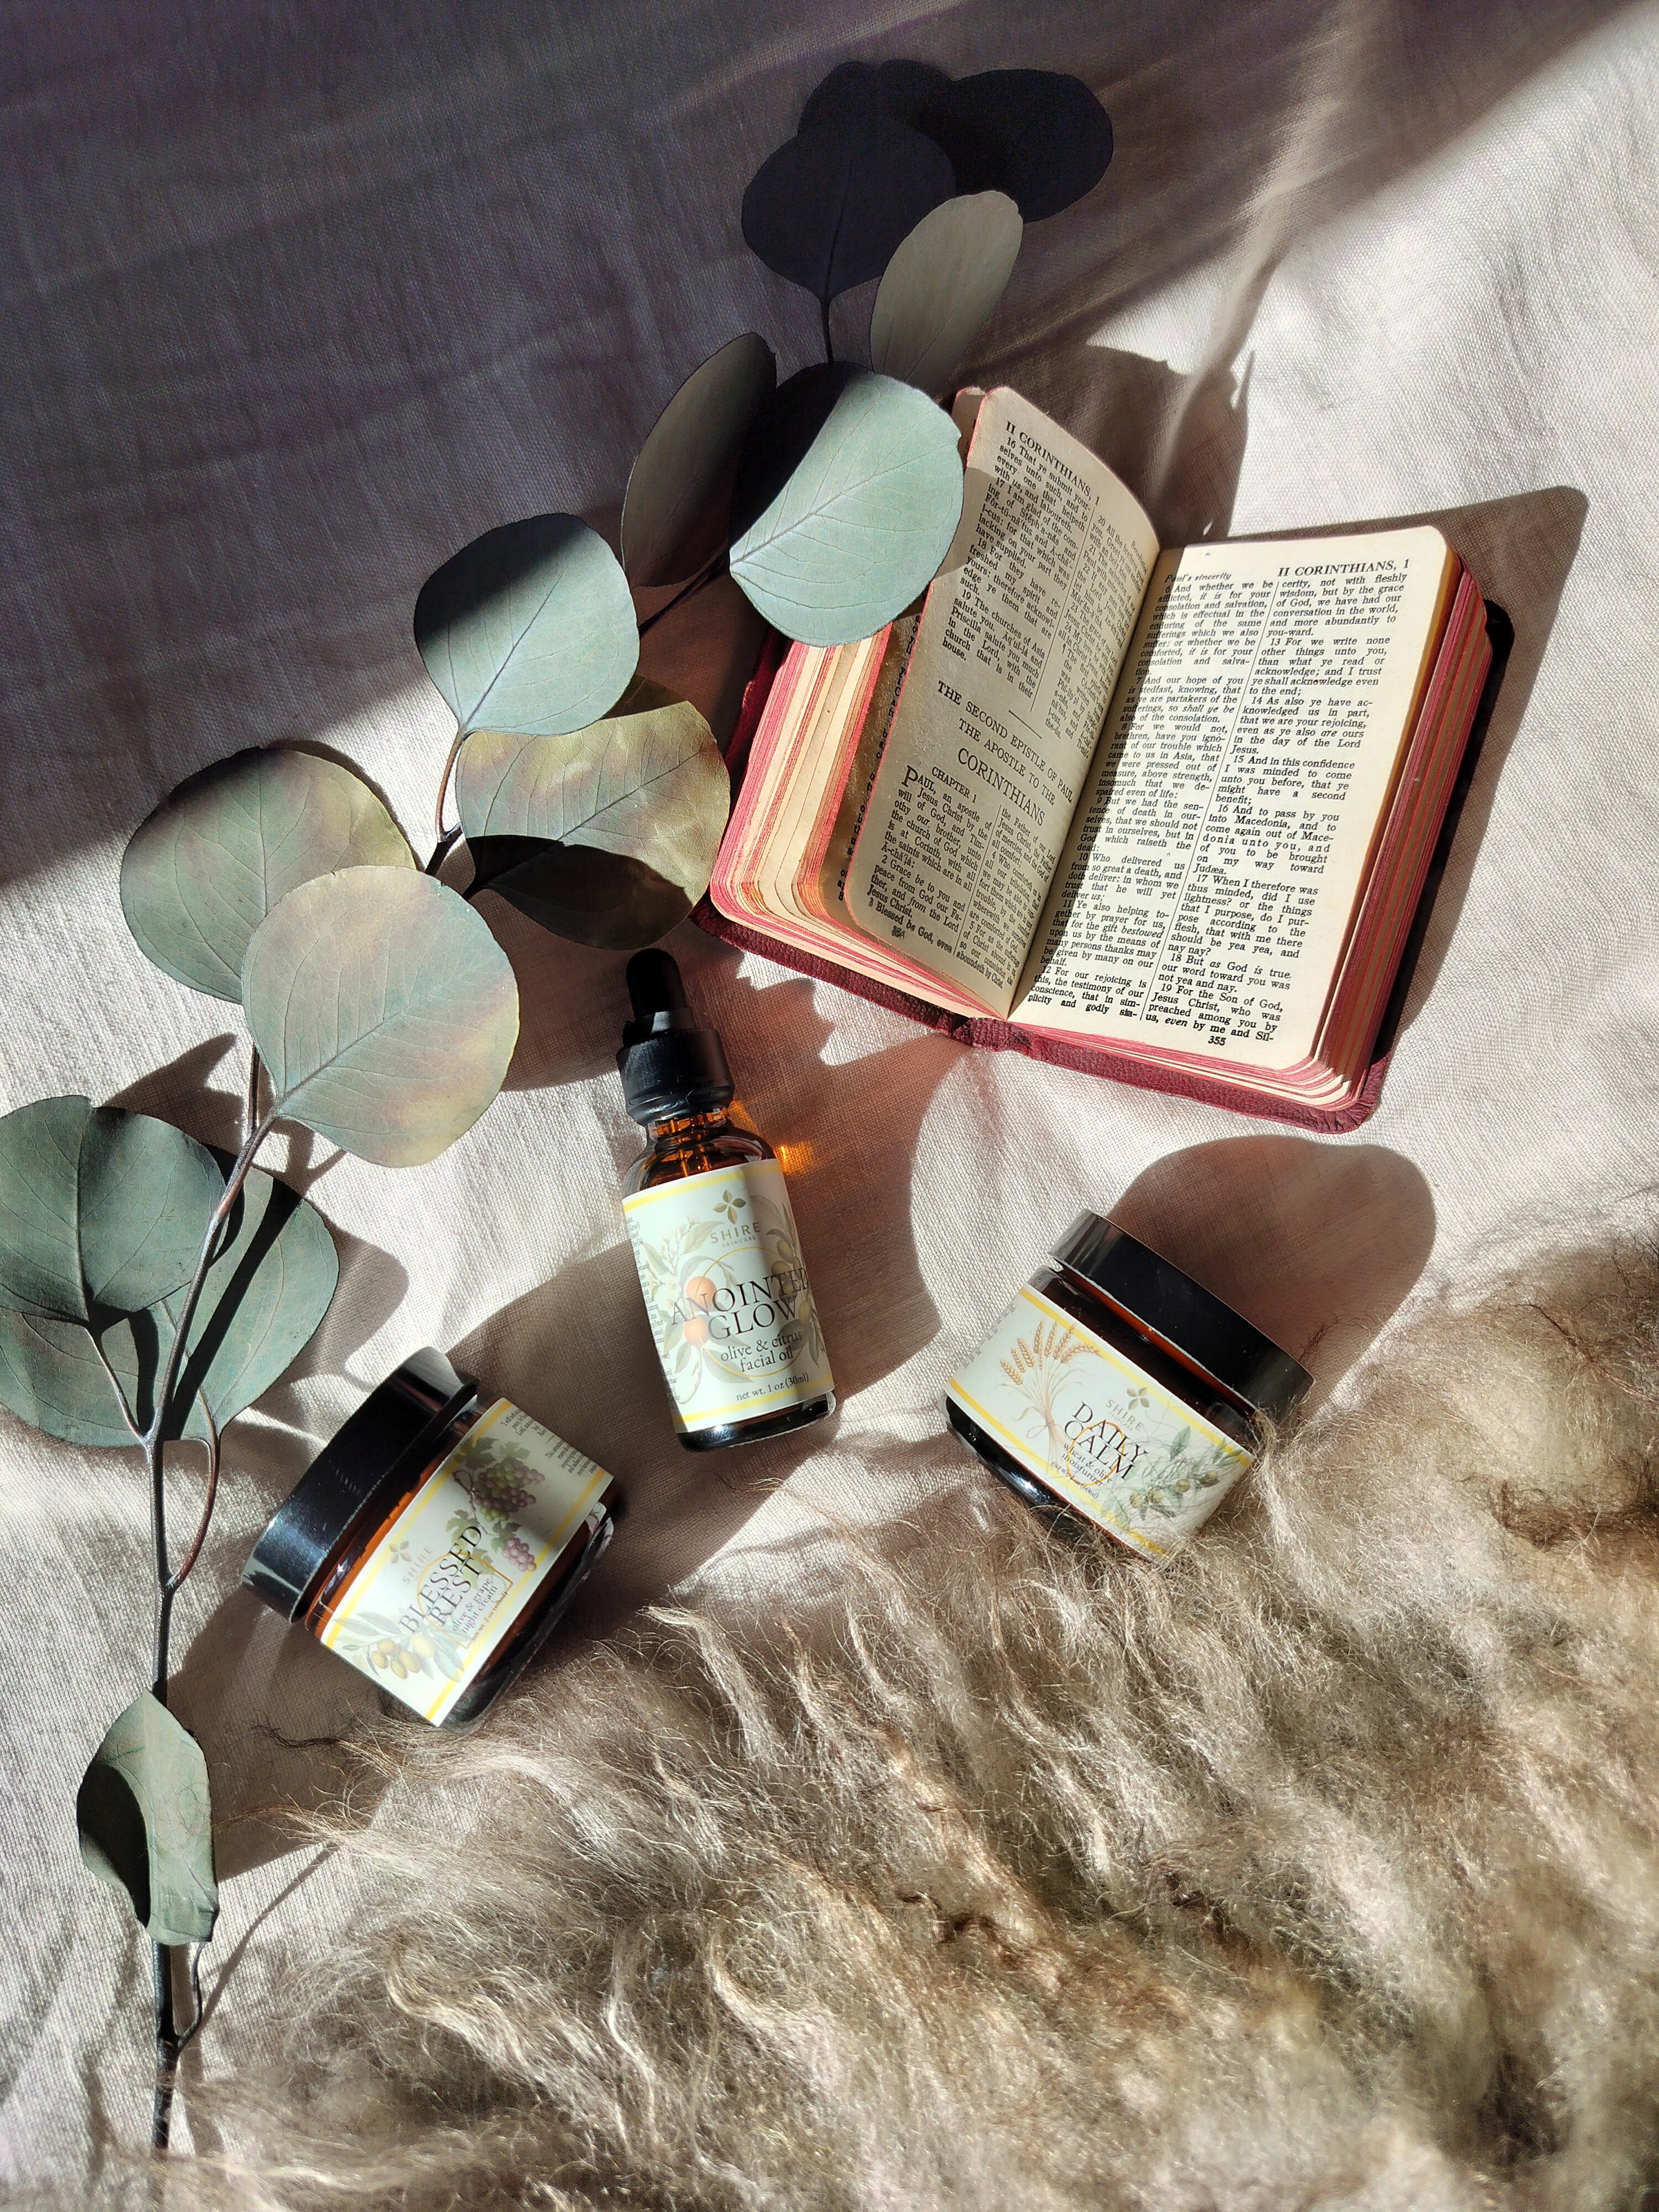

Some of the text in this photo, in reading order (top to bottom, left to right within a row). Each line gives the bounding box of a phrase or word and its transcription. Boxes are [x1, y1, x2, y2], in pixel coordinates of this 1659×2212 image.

[1005, 420, 1015, 435] II
[1019, 431, 1092, 500] CORINTHIANS,
[1000, 444, 1088, 522] selves unto such, and to
[1006, 437, 1091, 511] 16 That ye submit your-
[1165, 574, 1192, 583] Paul's
[1277, 559, 1409, 577] II CORINTHIANS, 1
[1282, 572, 1407, 589] cerity, not with fleshly
[1276, 599, 1286, 607] of
[1290, 599, 1311, 608] God,
[1363, 595, 1379, 603] had
[1322, 588, 1338, 596] but
[1342, 586, 1355, 597] by
[1359, 585, 1374, 594] the
[1378, 585, 1404, 594] grace
[1150, 621, 1185, 630] enduring
[1194, 619, 1204, 628] of
[1193, 610, 1230, 618] effectual
[1270, 618, 1288, 626] and
[1324, 615, 1380, 625] abundantly
[1266, 628, 1314, 637] you-ward.
[1284, 637, 1302, 646] For
[1261, 647, 1286, 655] other
[1295, 647, 1324, 657] things
[1335, 647, 1356, 655] unto
[1266, 697, 1279, 705] As
[1284, 697, 1304, 705] also
[1327, 697, 1351, 706] have
[937, 679, 1073, 803] THE SECOND EPISTLE OF PAUL
[959, 718, 1056, 806] THE APOSTLE TO THE
[1262, 767, 1300, 776] minded
[931, 766, 970, 798] CHAPTER
[957, 748, 1044, 826] CORINTHIANS
[901, 765, 992, 831] PAUL, an apostle of
[917, 787, 988, 841] Jesus Christ by the
[1083, 825, 1102, 833] trust
[1118, 827, 1160, 838] ourselves,
[1165, 830, 1181, 838] but
[1185, 832, 1194, 840] in
[1203, 834, 1330, 852] donia unto you, and
[1091, 882, 1108, 891] that
[1116, 884, 1127, 893] he
[1136, 888, 1153, 896] will
[1213, 876, 1241, 887] When
[1244, 879, 1250, 888] I
[1251, 881, 1295, 892] therefore
[1182, 968, 1206, 976] word
[1210, 971, 1244, 982] toward
[1247, 977, 1266, 986] you
[1271, 981, 1290, 990] was
[1028, 994, 1052, 1005] plicity
[1060, 1000, 1077, 1008] and
[1085, 1004, 1109, 1014] godly
[1208, 1035, 1226, 1046] 355
[711, 1222, 760, 1243] SHIRE
[671, 1268, 808, 1327] ANOINTED
[709, 1296, 799, 1340] GLOW
[720, 1330, 803, 1362] olive & citrus
[740, 1348, 794, 1373] facial oil
[736, 1391, 750, 1400] net
[752, 1387, 765, 1396] wt.
[768, 1384, 773, 1393] 1
[785, 1372, 809, 1389] (30ml)
[1106, 1399, 1144, 1432] SHIRE
[1072, 1401, 1149, 1464] DAILY
[1064, 1420, 1135, 1480] CALM
[1064, 1443, 1085, 1463] wheat
[1062, 1453, 1104, 1487] moisturizer
[402, 1546, 432, 1585] SHIRE
[400, 1526, 482, 1633] BLESSED
[428, 1558, 482, 1626] REST
[453, 1578, 491, 1631] olive & grape
[462, 1586, 498, 1633] night cream
